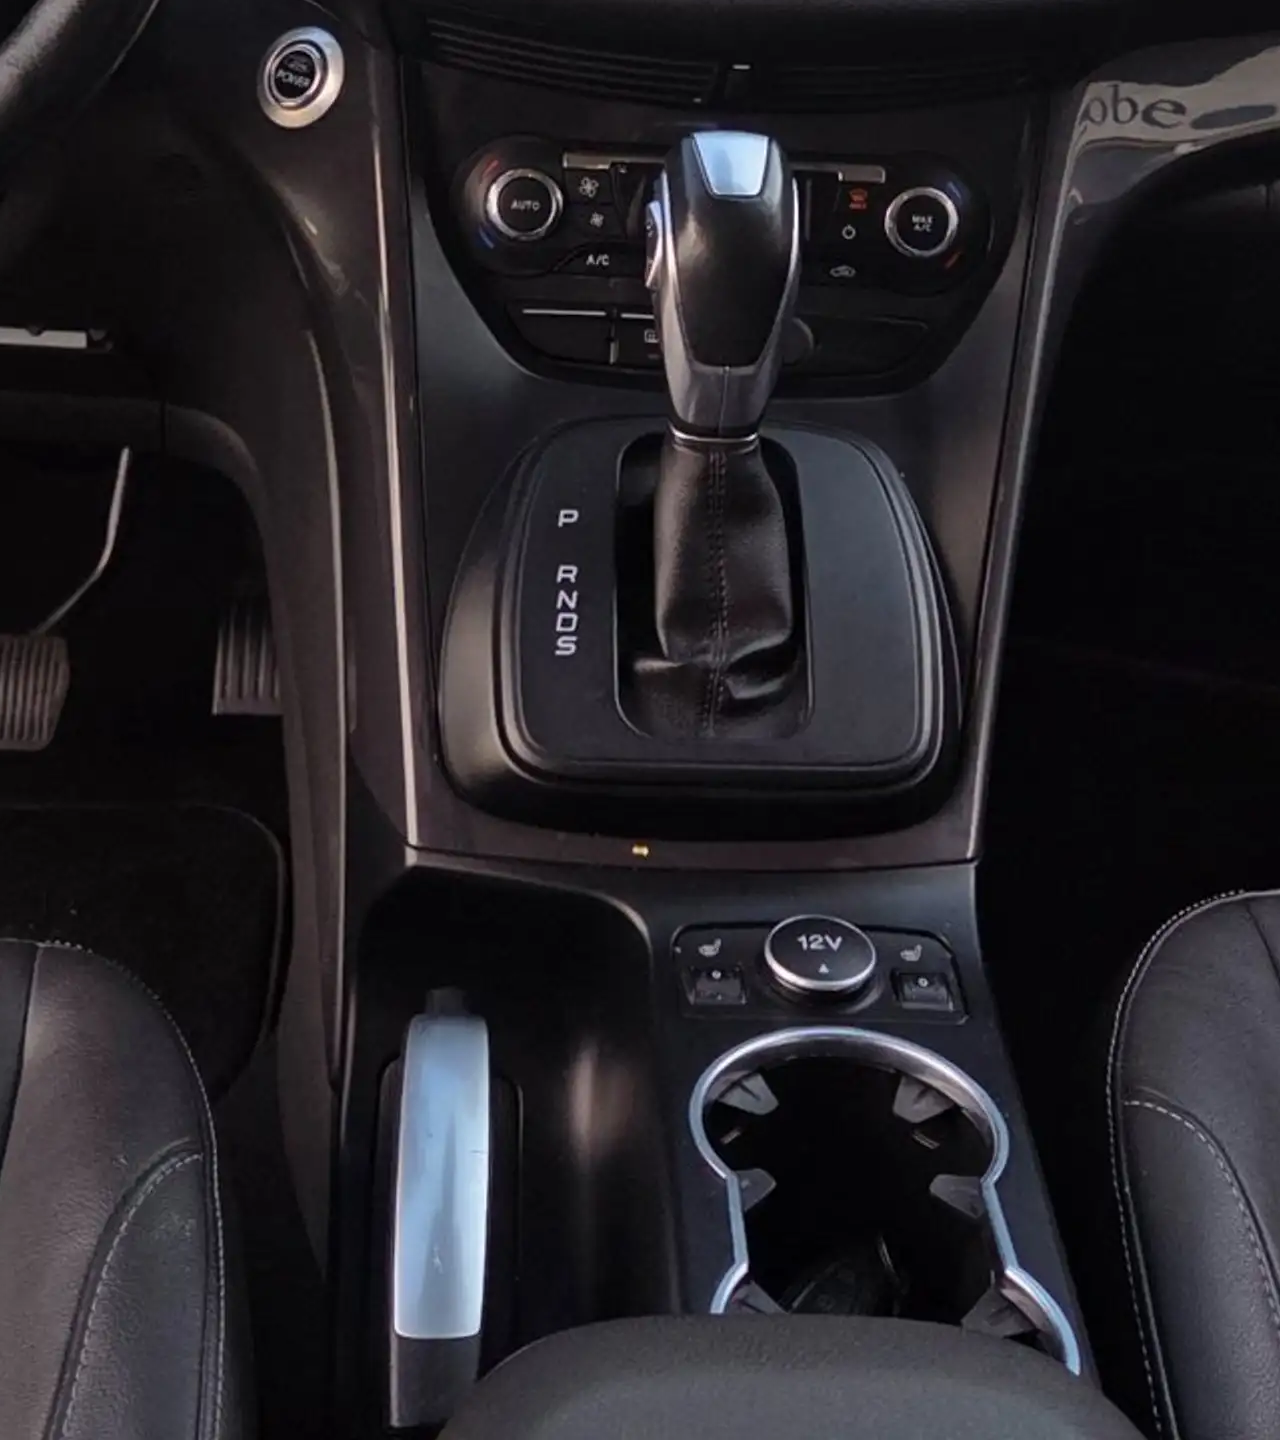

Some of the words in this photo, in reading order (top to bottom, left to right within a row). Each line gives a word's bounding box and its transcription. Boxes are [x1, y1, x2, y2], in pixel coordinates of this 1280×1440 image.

[510, 199, 541, 211] AUTO
[586, 253, 610, 266] A/C
[558, 509, 579, 528] P
[556, 565, 578, 583] R
[556, 590, 578, 609] N
[555, 612, 578, 632] D
[554, 636, 578, 655] S
[796, 934, 843, 953] 12V
